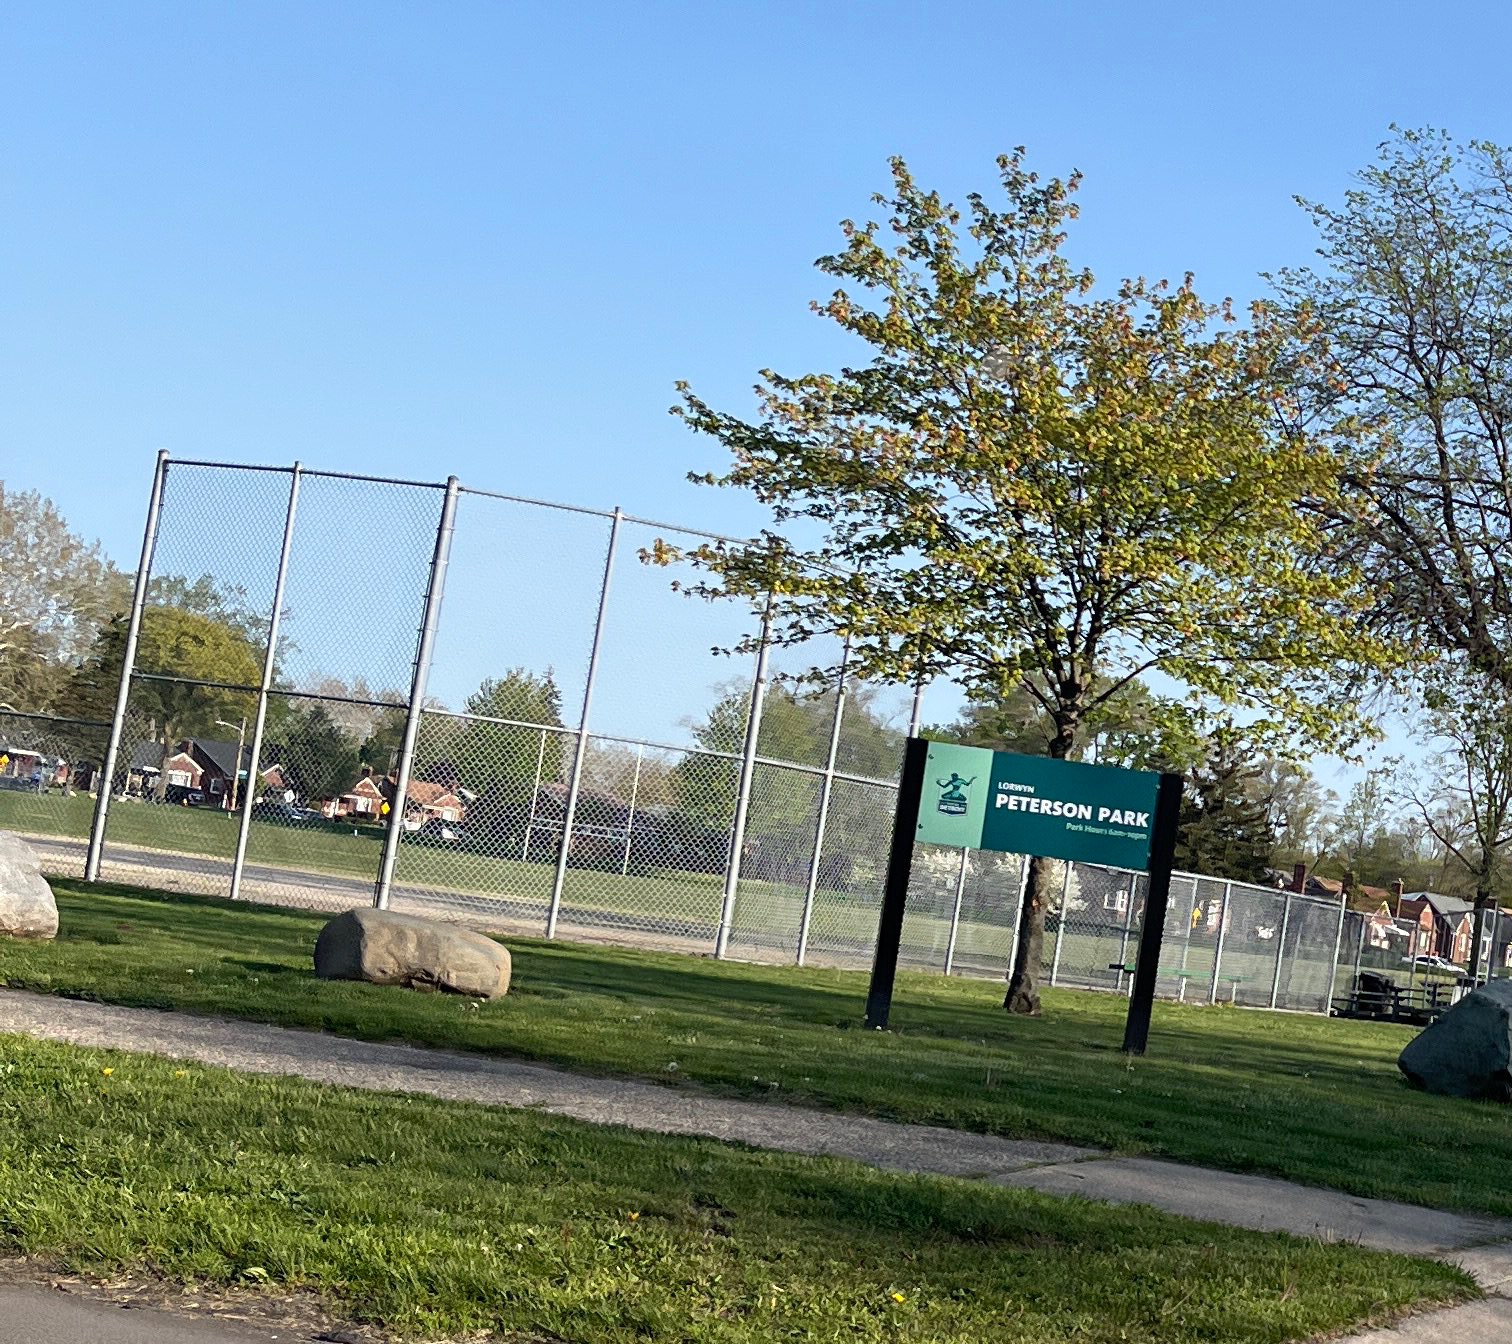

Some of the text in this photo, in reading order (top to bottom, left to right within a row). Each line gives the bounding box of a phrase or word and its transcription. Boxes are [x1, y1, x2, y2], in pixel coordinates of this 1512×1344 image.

[995, 793, 1150, 828] PETERSON PARK
[1066, 822, 1084, 832] Park
